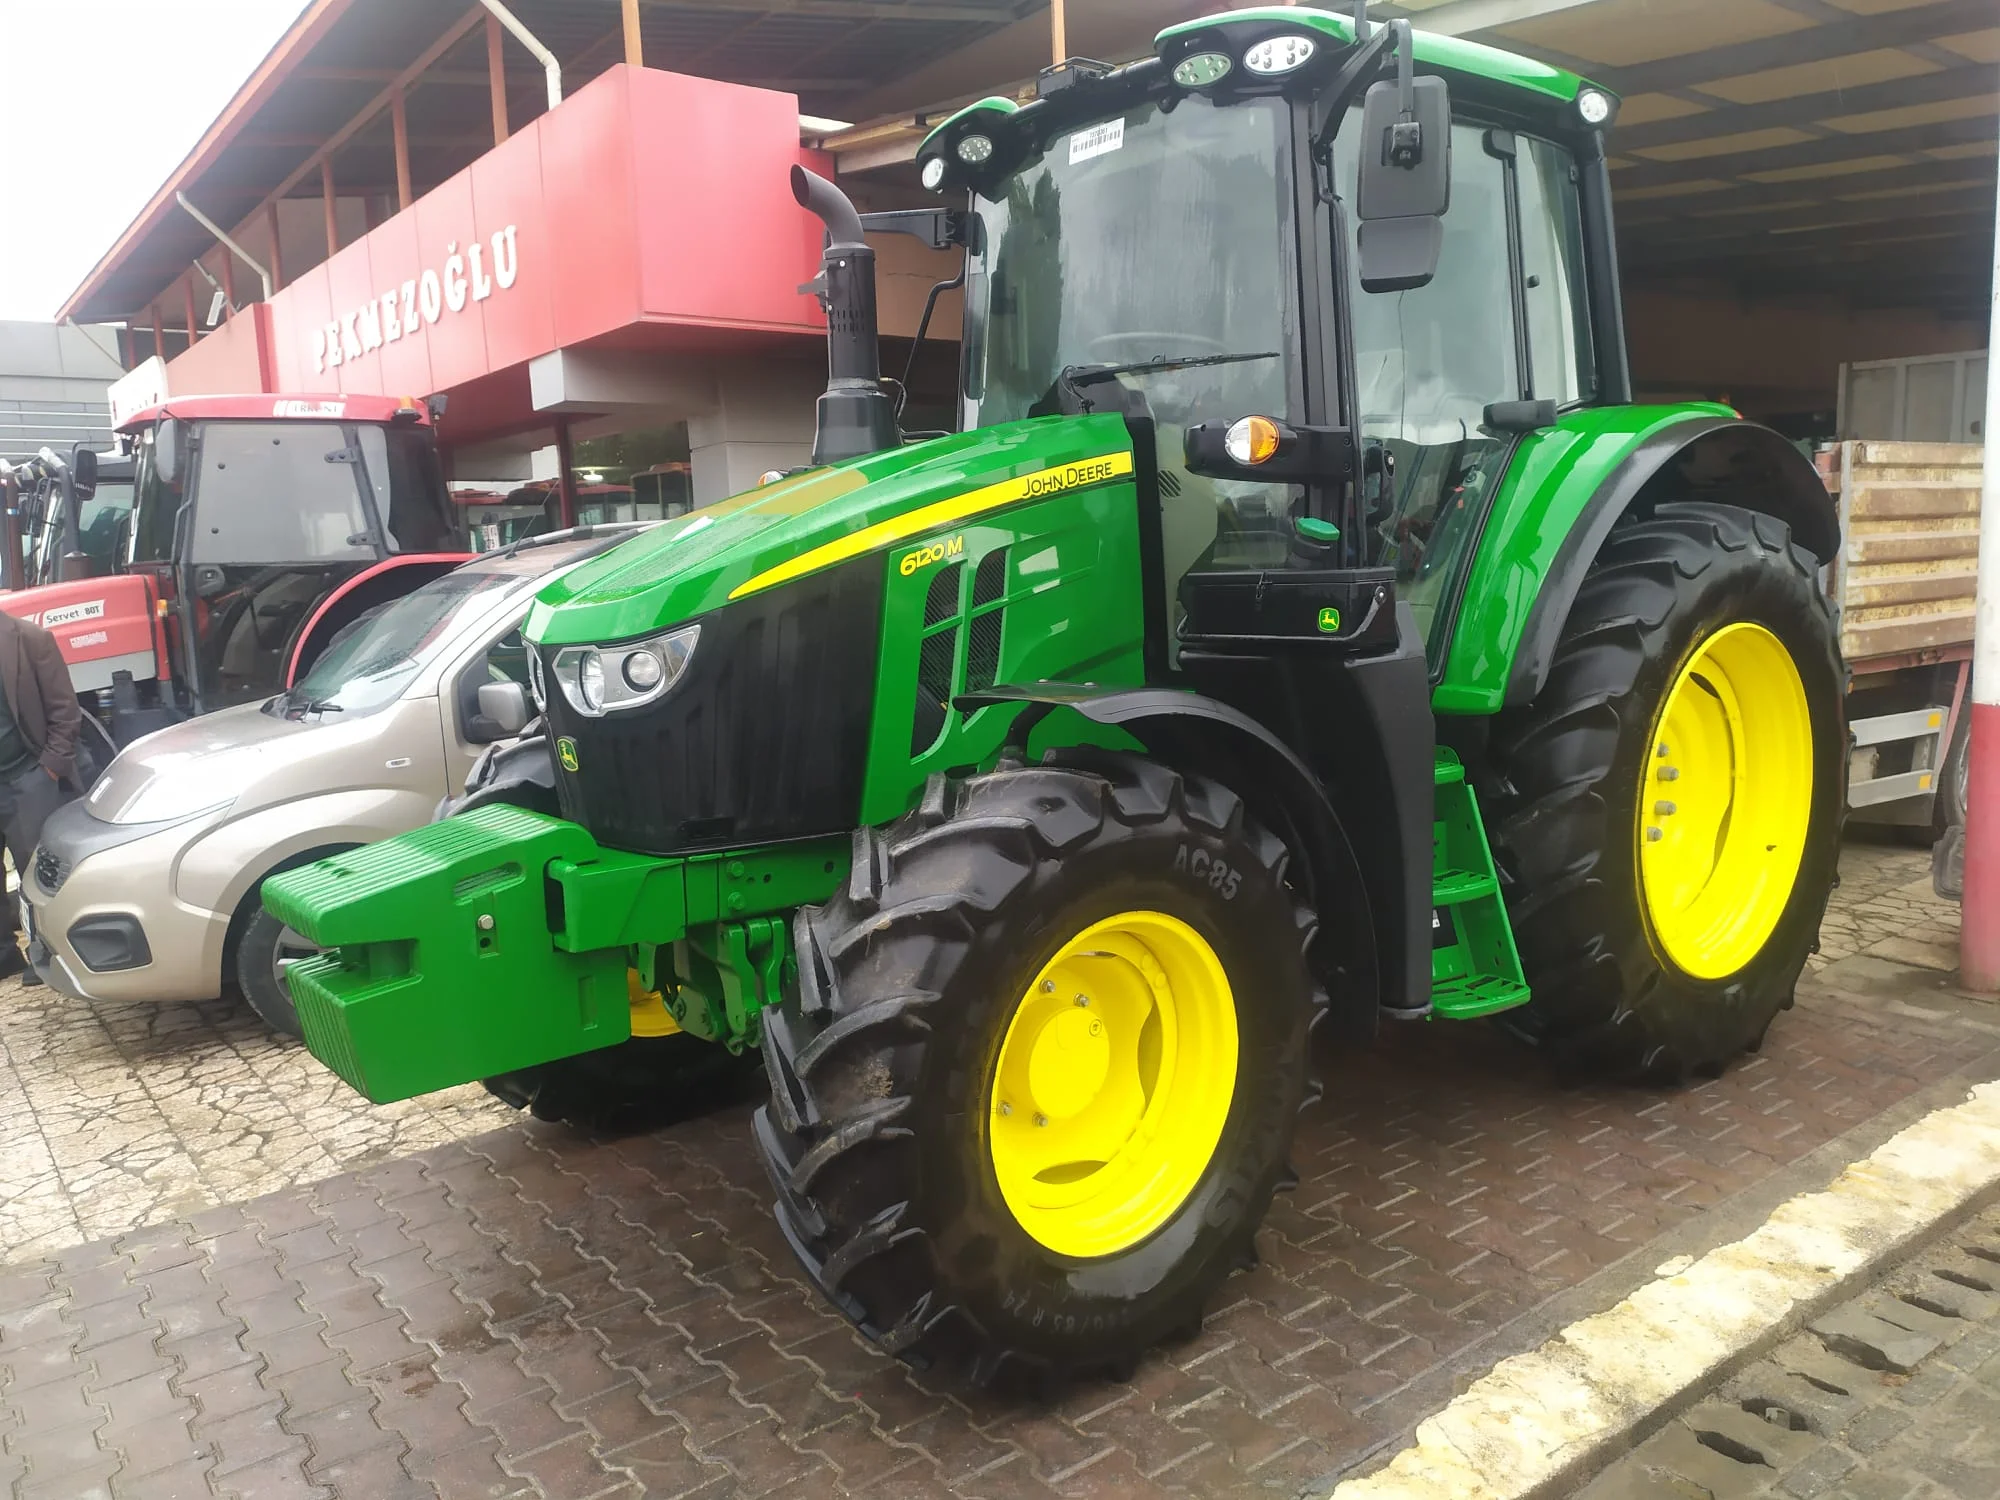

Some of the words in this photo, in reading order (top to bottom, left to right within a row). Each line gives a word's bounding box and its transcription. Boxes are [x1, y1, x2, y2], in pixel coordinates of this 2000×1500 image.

[312, 224, 517, 375] PEKMEZOĞLU
[1022, 473, 1063, 497] JOHN
[1066, 461, 1113, 486] DEERE
[46, 609, 80, 624] Servet
[1174, 843, 1242, 900] AC85
